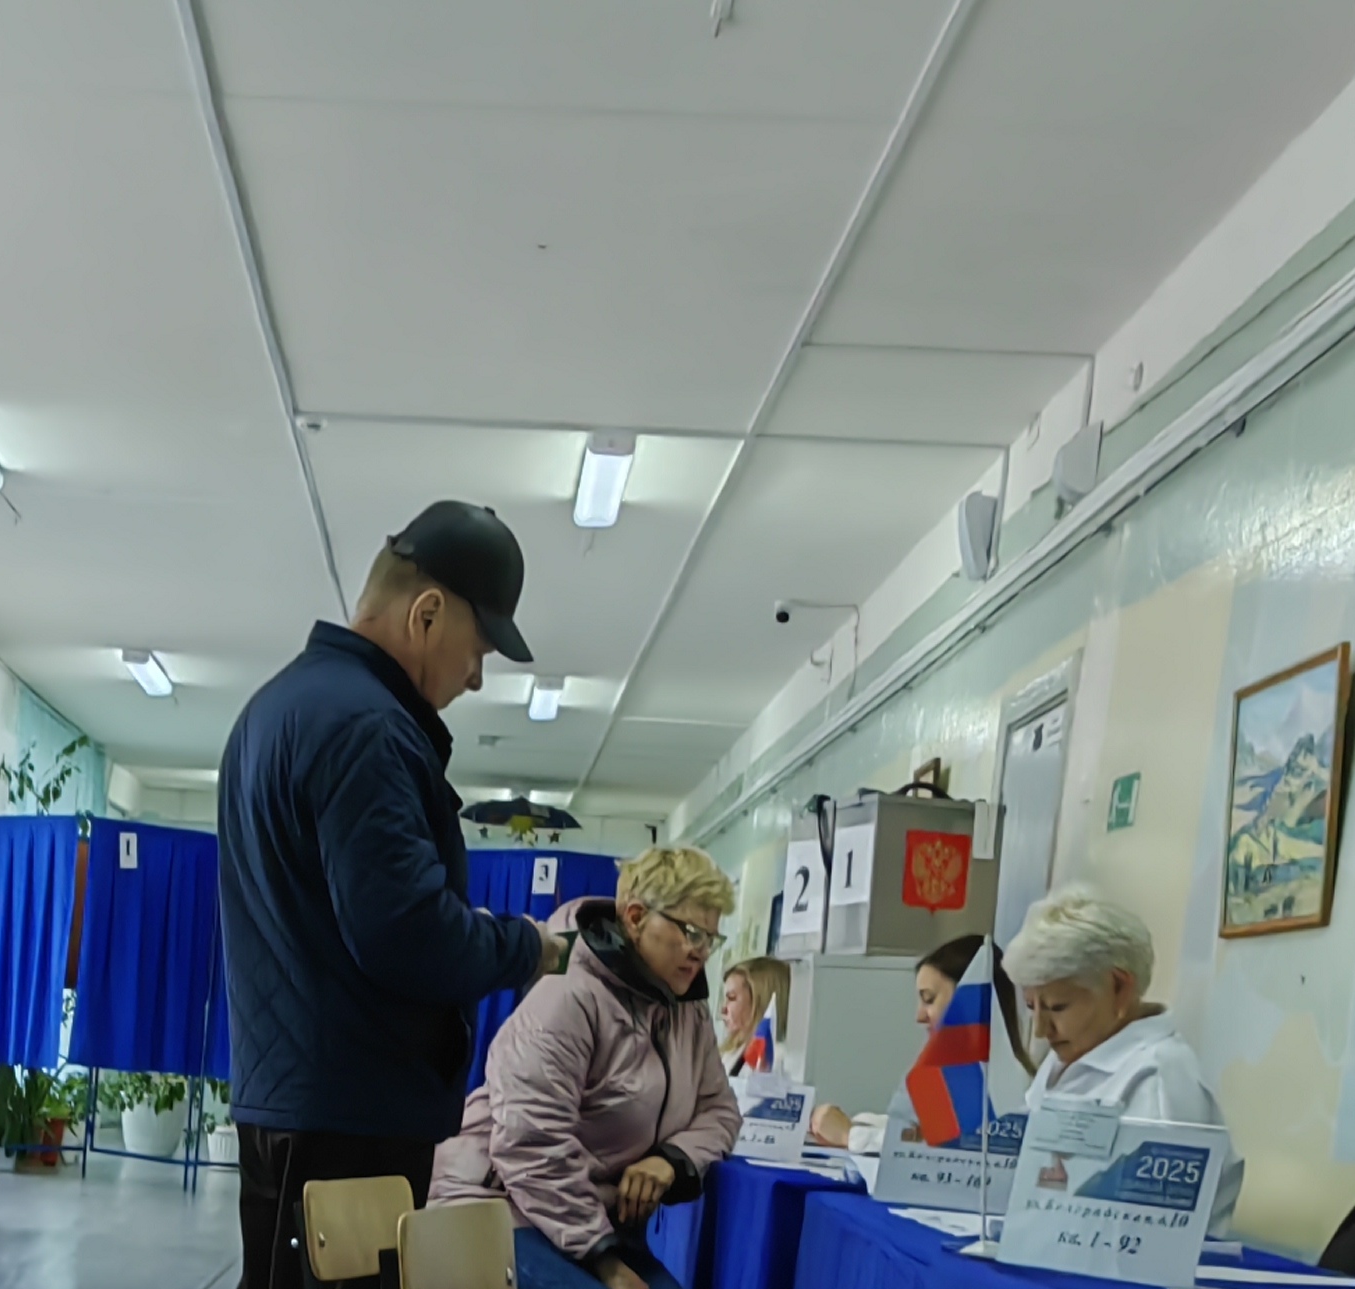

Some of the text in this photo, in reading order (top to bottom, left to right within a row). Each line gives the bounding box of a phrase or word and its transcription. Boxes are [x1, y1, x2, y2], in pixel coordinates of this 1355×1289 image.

[792, 865, 810, 913] 2
[844, 849, 854, 889] 1
[1136, 1155, 1201, 1184] 2025
